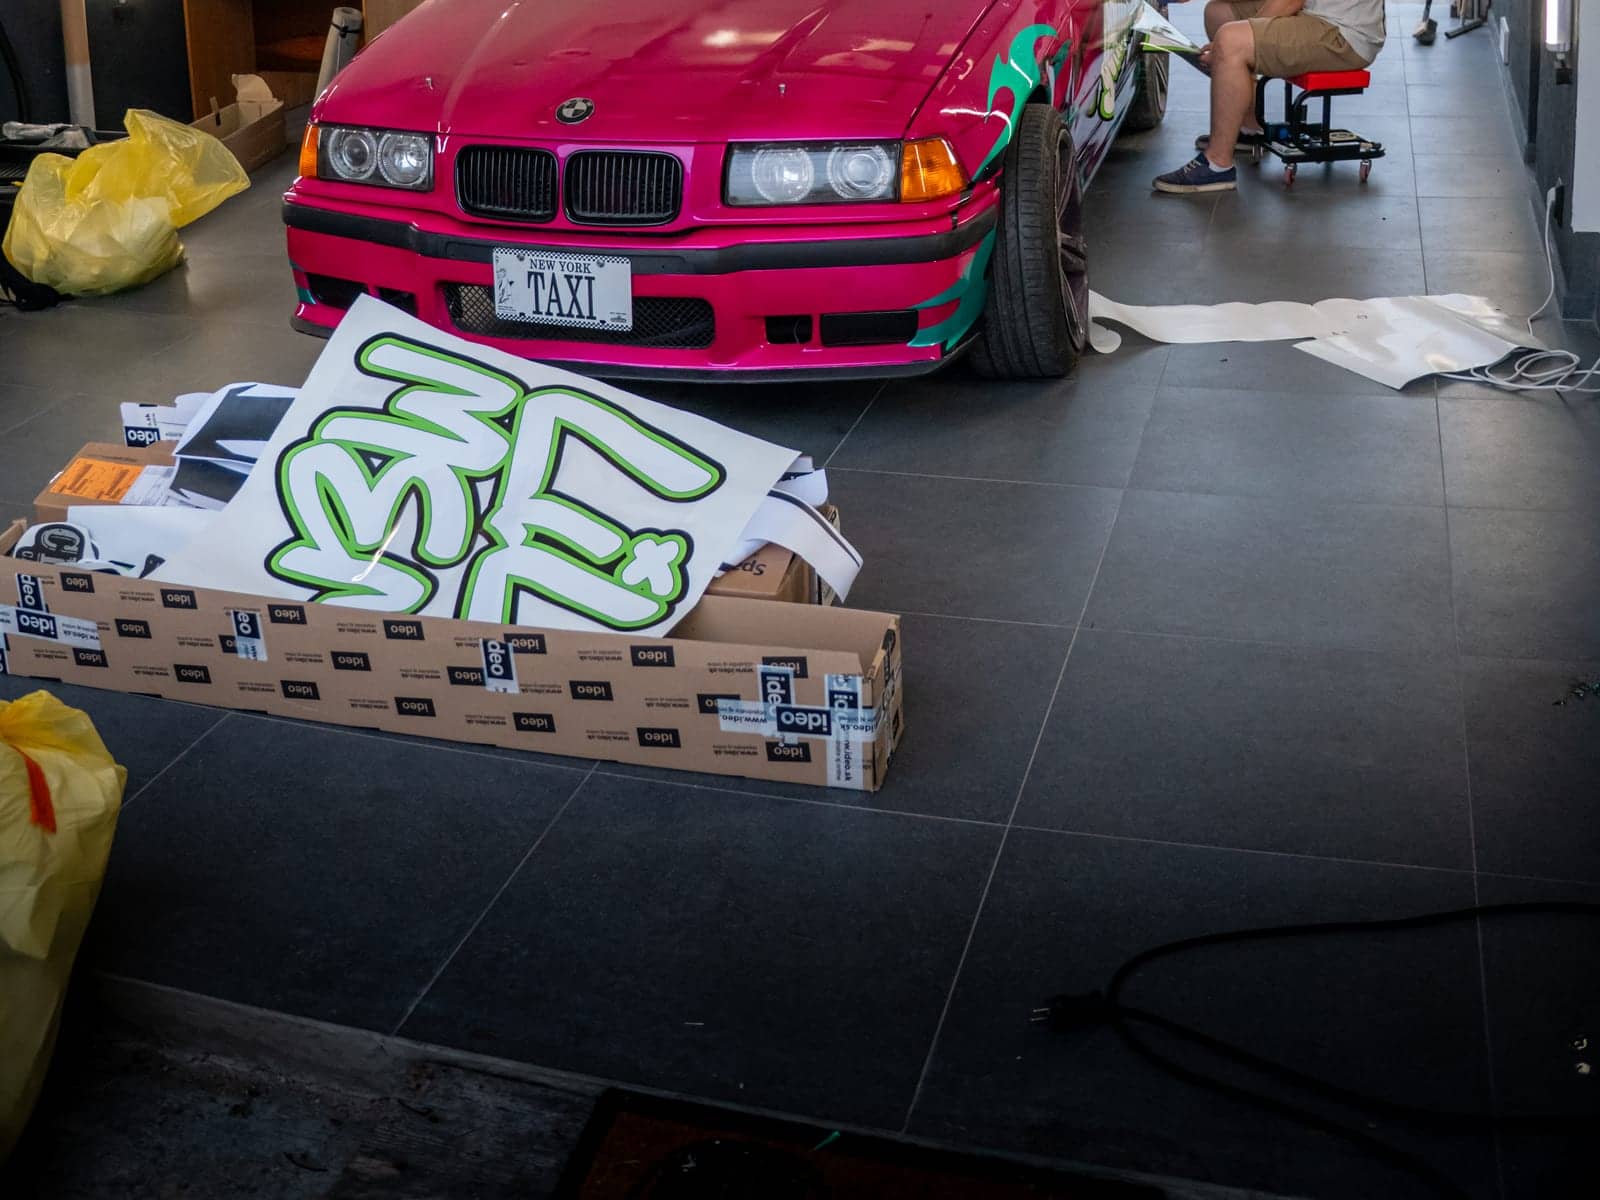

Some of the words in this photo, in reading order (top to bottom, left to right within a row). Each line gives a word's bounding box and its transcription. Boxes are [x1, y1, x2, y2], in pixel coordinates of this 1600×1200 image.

[530, 259, 556, 272] NEW
[559, 261, 592, 274] YORK
[527, 271, 597, 320] TAXI
[127, 430, 158, 445] ideo
[66, 577, 90, 590] ideo
[21, 575, 36, 606] deo
[166, 593, 192, 606] ideo
[275, 609, 300, 621] ideo
[20, 614, 56, 636] ideo
[121, 623, 145, 634] ideo
[391, 625, 418, 637] ideo
[512, 638, 540, 650] ideo
[338, 656, 365, 668] ideo
[487, 640, 506, 676] deo
[638, 651, 668, 664] ideo
[181, 669, 205, 680] ideo
[455, 672, 482, 683] ideo
[288, 685, 313, 697] ideo
[577, 685, 606, 697] ideo
[402, 702, 429, 714] ideo
[520, 718, 548, 729] ideo
[781, 711, 829, 732] ideo
[645, 732, 673, 744] ideo
[774, 745, 804, 758] ideo
